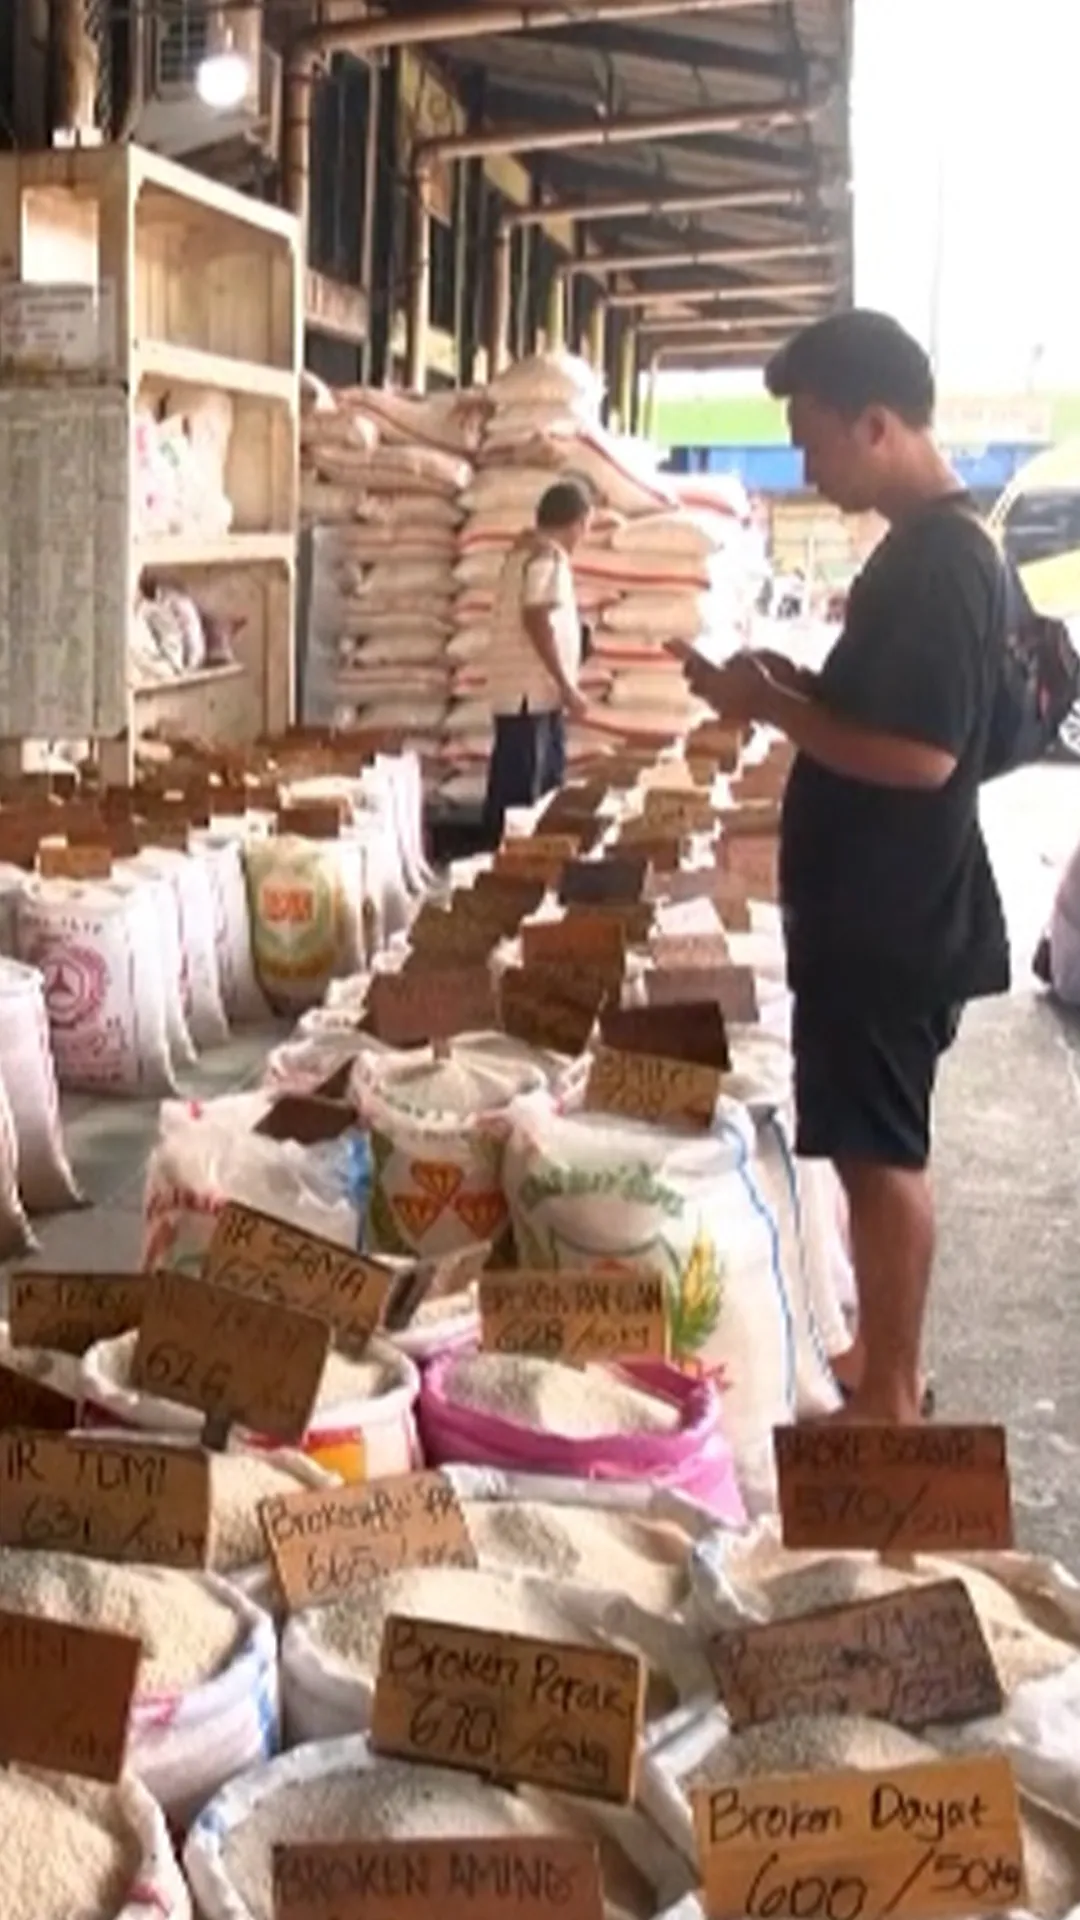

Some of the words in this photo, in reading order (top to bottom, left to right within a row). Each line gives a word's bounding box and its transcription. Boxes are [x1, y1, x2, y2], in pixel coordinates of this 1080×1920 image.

[6, 1438, 46, 1483] IR
[388, 1620, 521, 1689] Broken
[530, 1651, 629, 1719] Perak
[709, 1786, 843, 1843] Broken
[870, 1781, 989, 1843] Dayat
